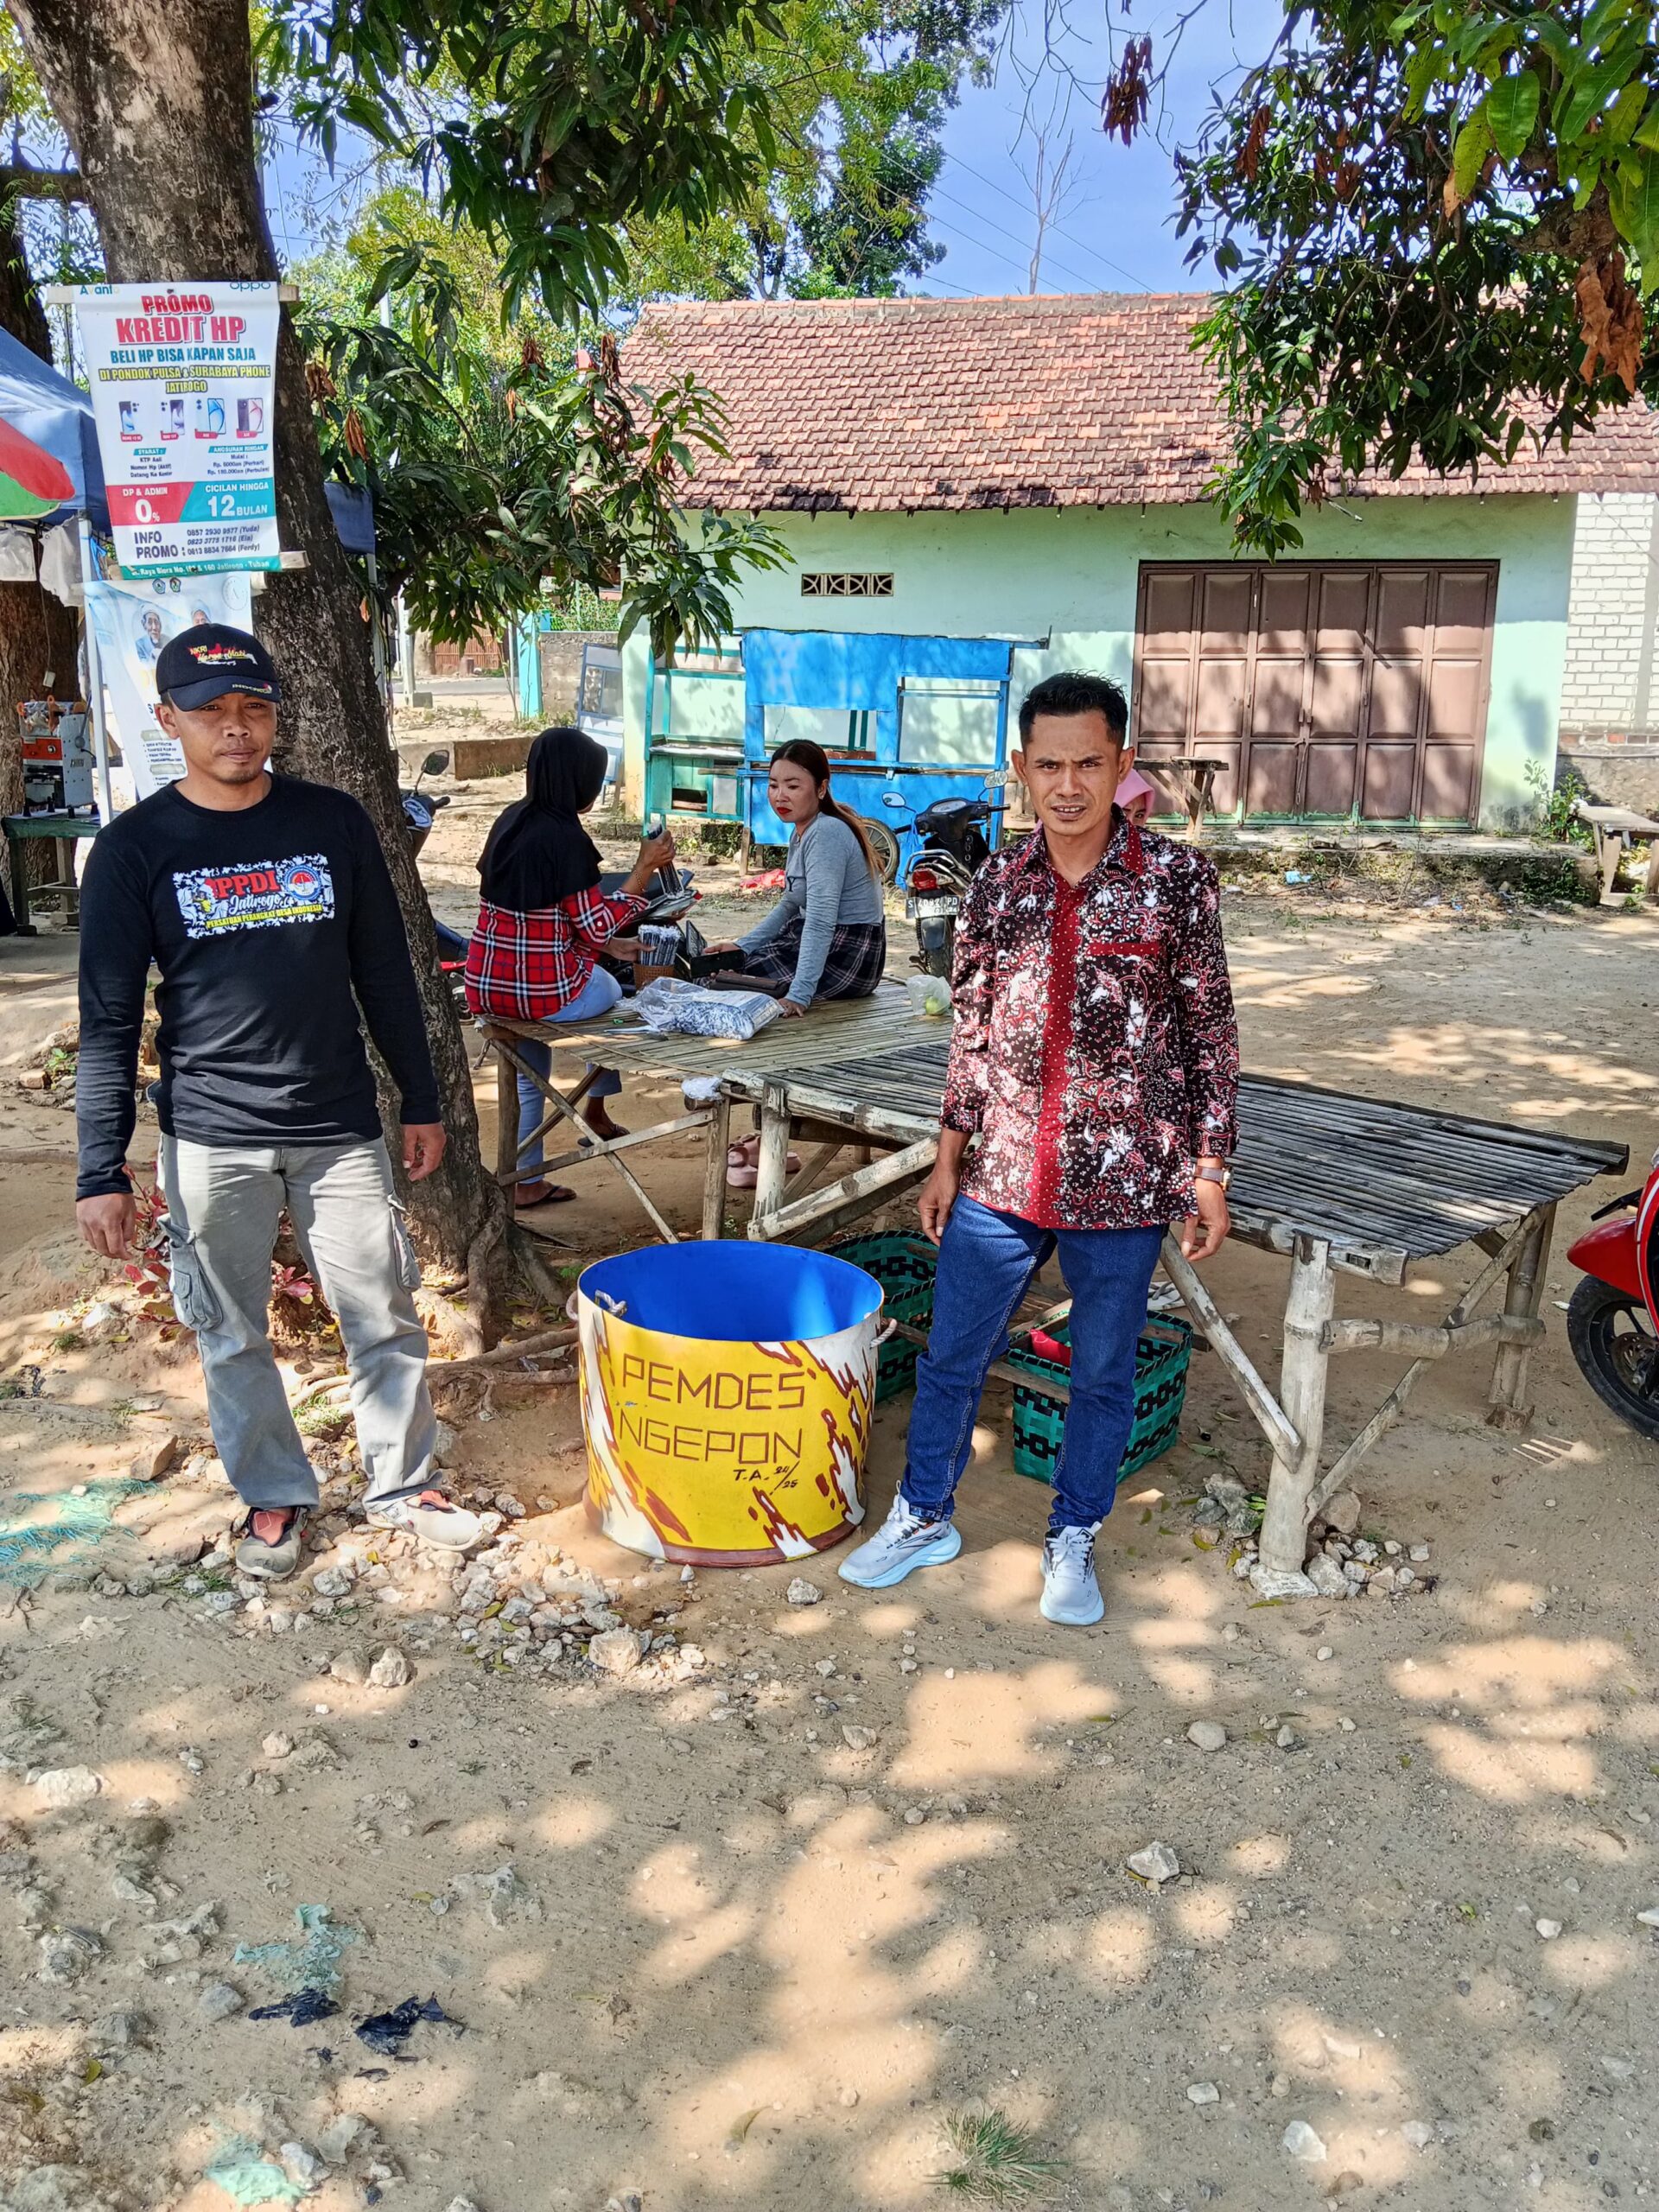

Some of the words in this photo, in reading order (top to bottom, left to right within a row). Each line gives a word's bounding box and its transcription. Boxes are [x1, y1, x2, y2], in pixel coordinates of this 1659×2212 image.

[141, 295, 214, 315] PROMO
[116, 316, 206, 345] KREDIT
[210, 315, 246, 342] HP
[111, 349, 135, 364] BELI
[139, 350, 154, 363] HP
[157, 348, 185, 362] BISA
[187, 348, 225, 361] KAPAN
[227, 347, 256, 360] SAJA
[99, 367, 111, 381] DI
[111, 367, 152, 380] PONDOK
[152, 366, 181, 379] PULSA
[182, 368, 189, 378] &
[189, 365, 238, 378] SURABAYA
[239, 365, 271, 378] PHONE
[165, 380, 208, 394] JATIROGO
[123, 488, 135, 497] DP
[137, 487, 142, 496] &
[144, 486, 168, 496] ADMIN
[206, 484, 238, 493] CICILAN
[239, 482, 269, 492] HINGGA
[207, 494, 235, 518] 12
[236, 504, 268, 516] BULAN
[134, 531, 162, 544] INFO
[137, 544, 179, 559] PROMO
[190, 645, 207, 655] NKRI
[217, 870, 282, 899] PPDI
[228, 894, 283, 915] Jatirogo
[907, 899, 913, 908] S
[947, 897, 958, 906] PD
[207, 916, 242, 929] PERSATUAN
[242, 910, 276, 922] PERANGKAT
[292, 904, 323, 914] INDONESIA
[623, 1353, 805, 1410] PEMDES
[620, 1408, 803, 1464] NGEPON
